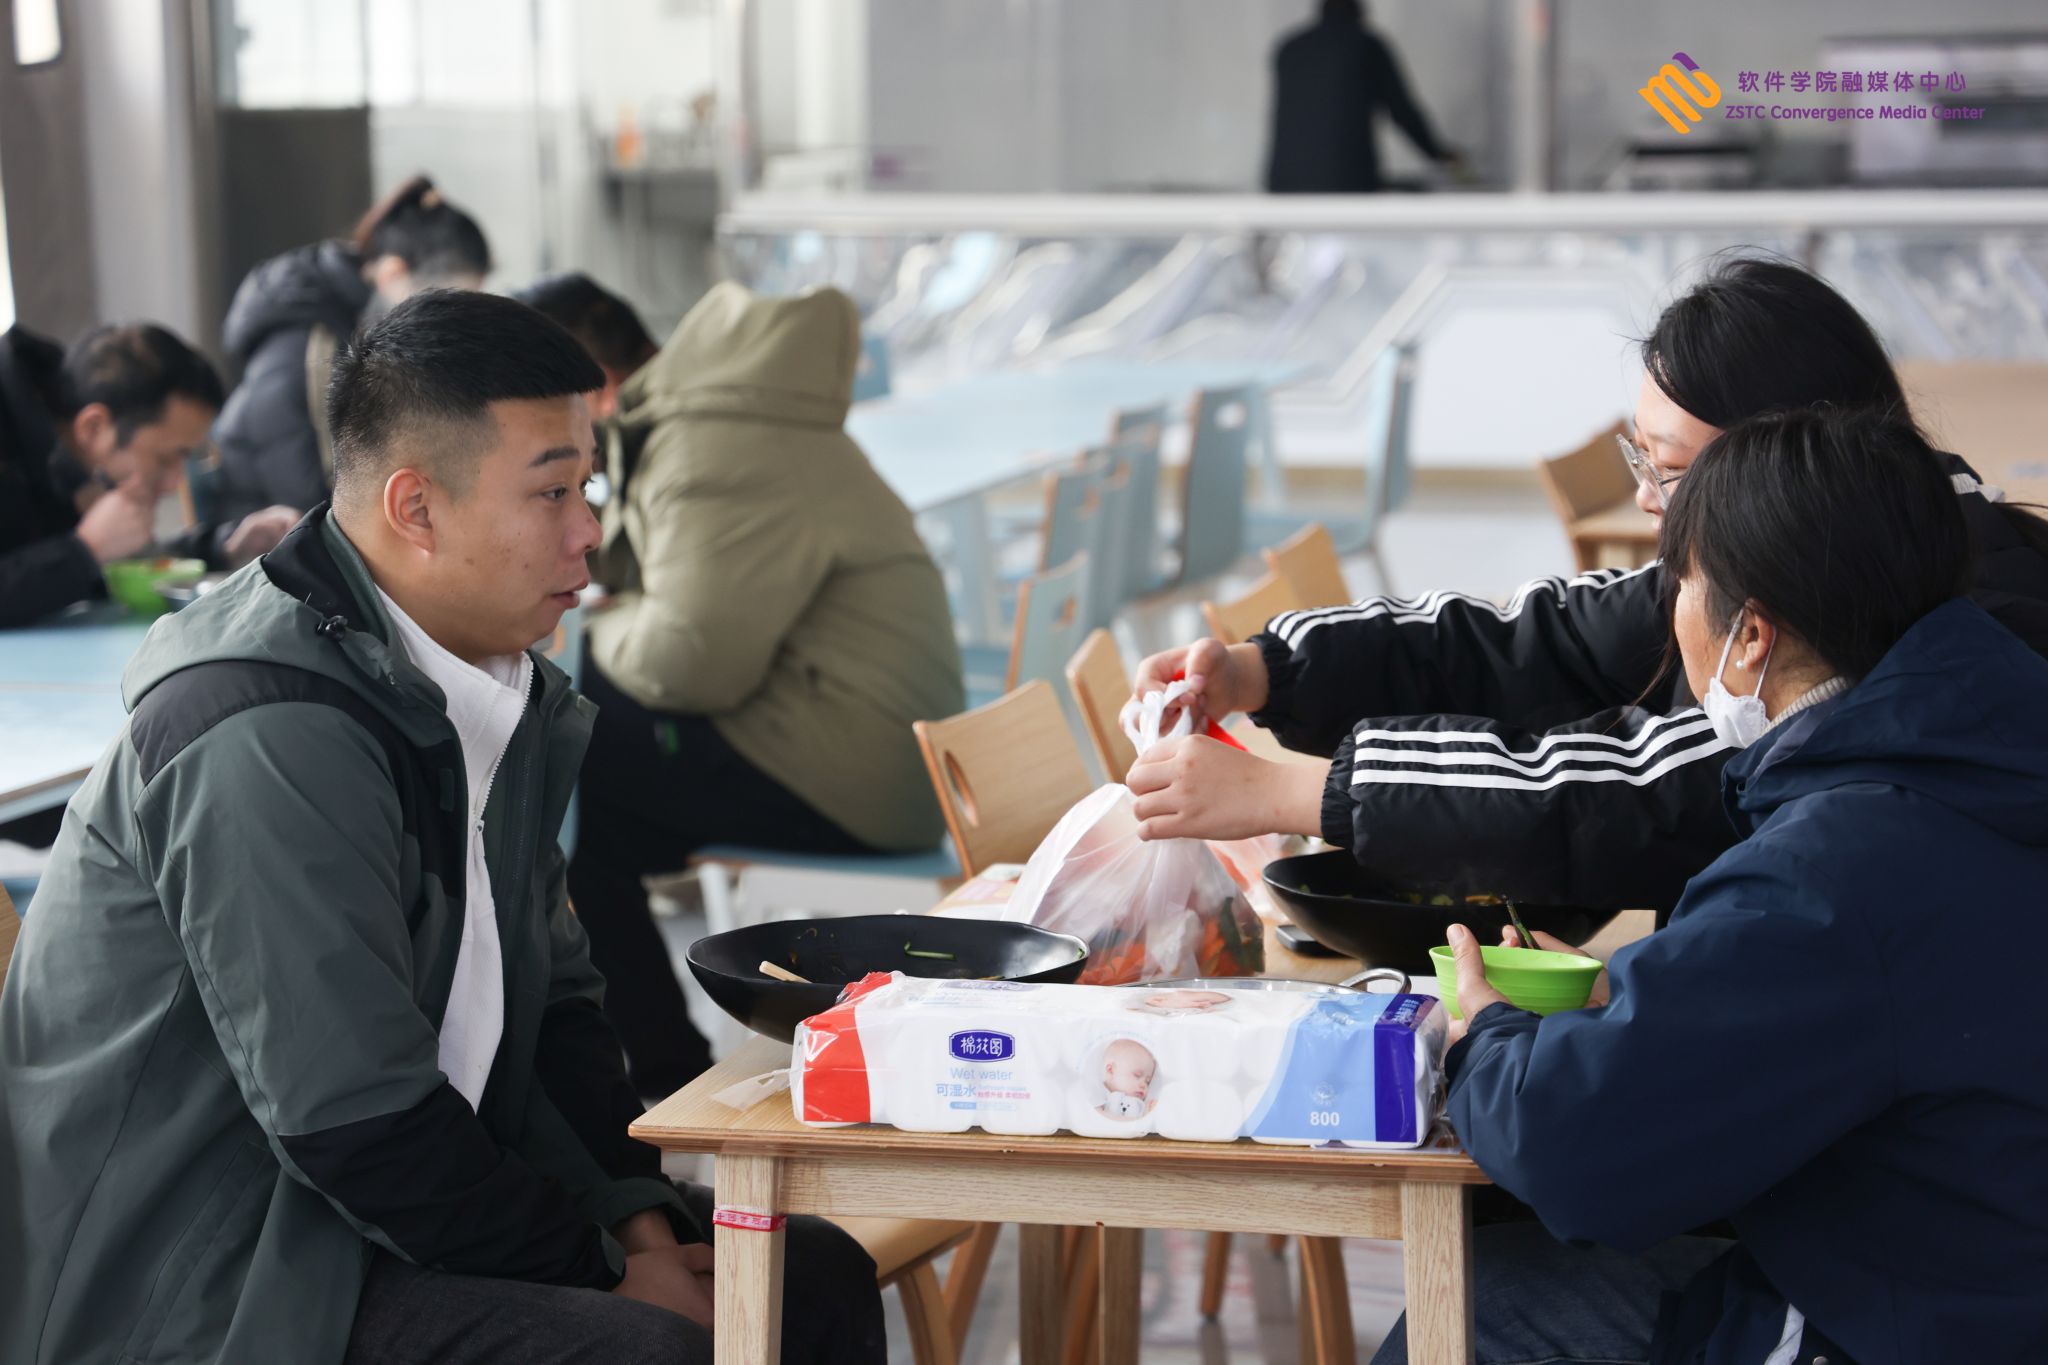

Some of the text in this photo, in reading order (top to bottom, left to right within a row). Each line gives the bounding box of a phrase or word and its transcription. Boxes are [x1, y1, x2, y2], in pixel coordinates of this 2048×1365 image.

[950, 1067, 1013, 1080] Wet water
[936, 1083, 977, 1098] 可湿水
[1310, 1111, 1340, 1126] 800
